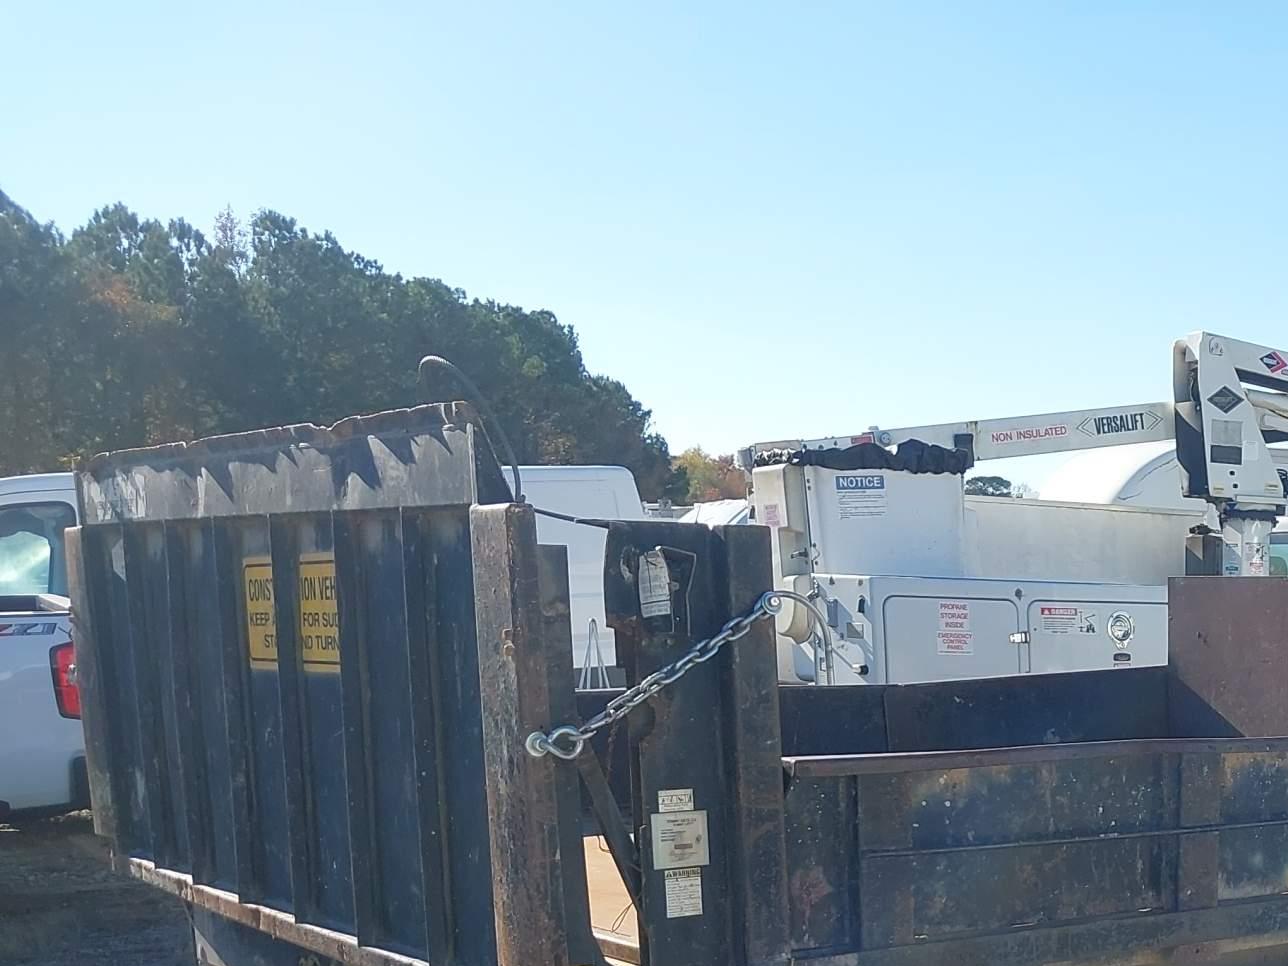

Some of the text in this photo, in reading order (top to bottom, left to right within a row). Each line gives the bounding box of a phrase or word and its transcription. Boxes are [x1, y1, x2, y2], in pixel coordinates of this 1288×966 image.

[1093, 412, 1145, 436] VERSALIFT
[992, 425, 1067, 443] NON INSULATED
[839, 476, 881, 488] NOTICE
[248, 578, 273, 602] CONS
[318, 575, 336, 600] VEH
[250, 612, 338, 628] KEEP FOR SUD
[303, 636, 313, 650] ND
[315, 635, 338, 651] TURN
[672, 869, 700, 877] WARNING
